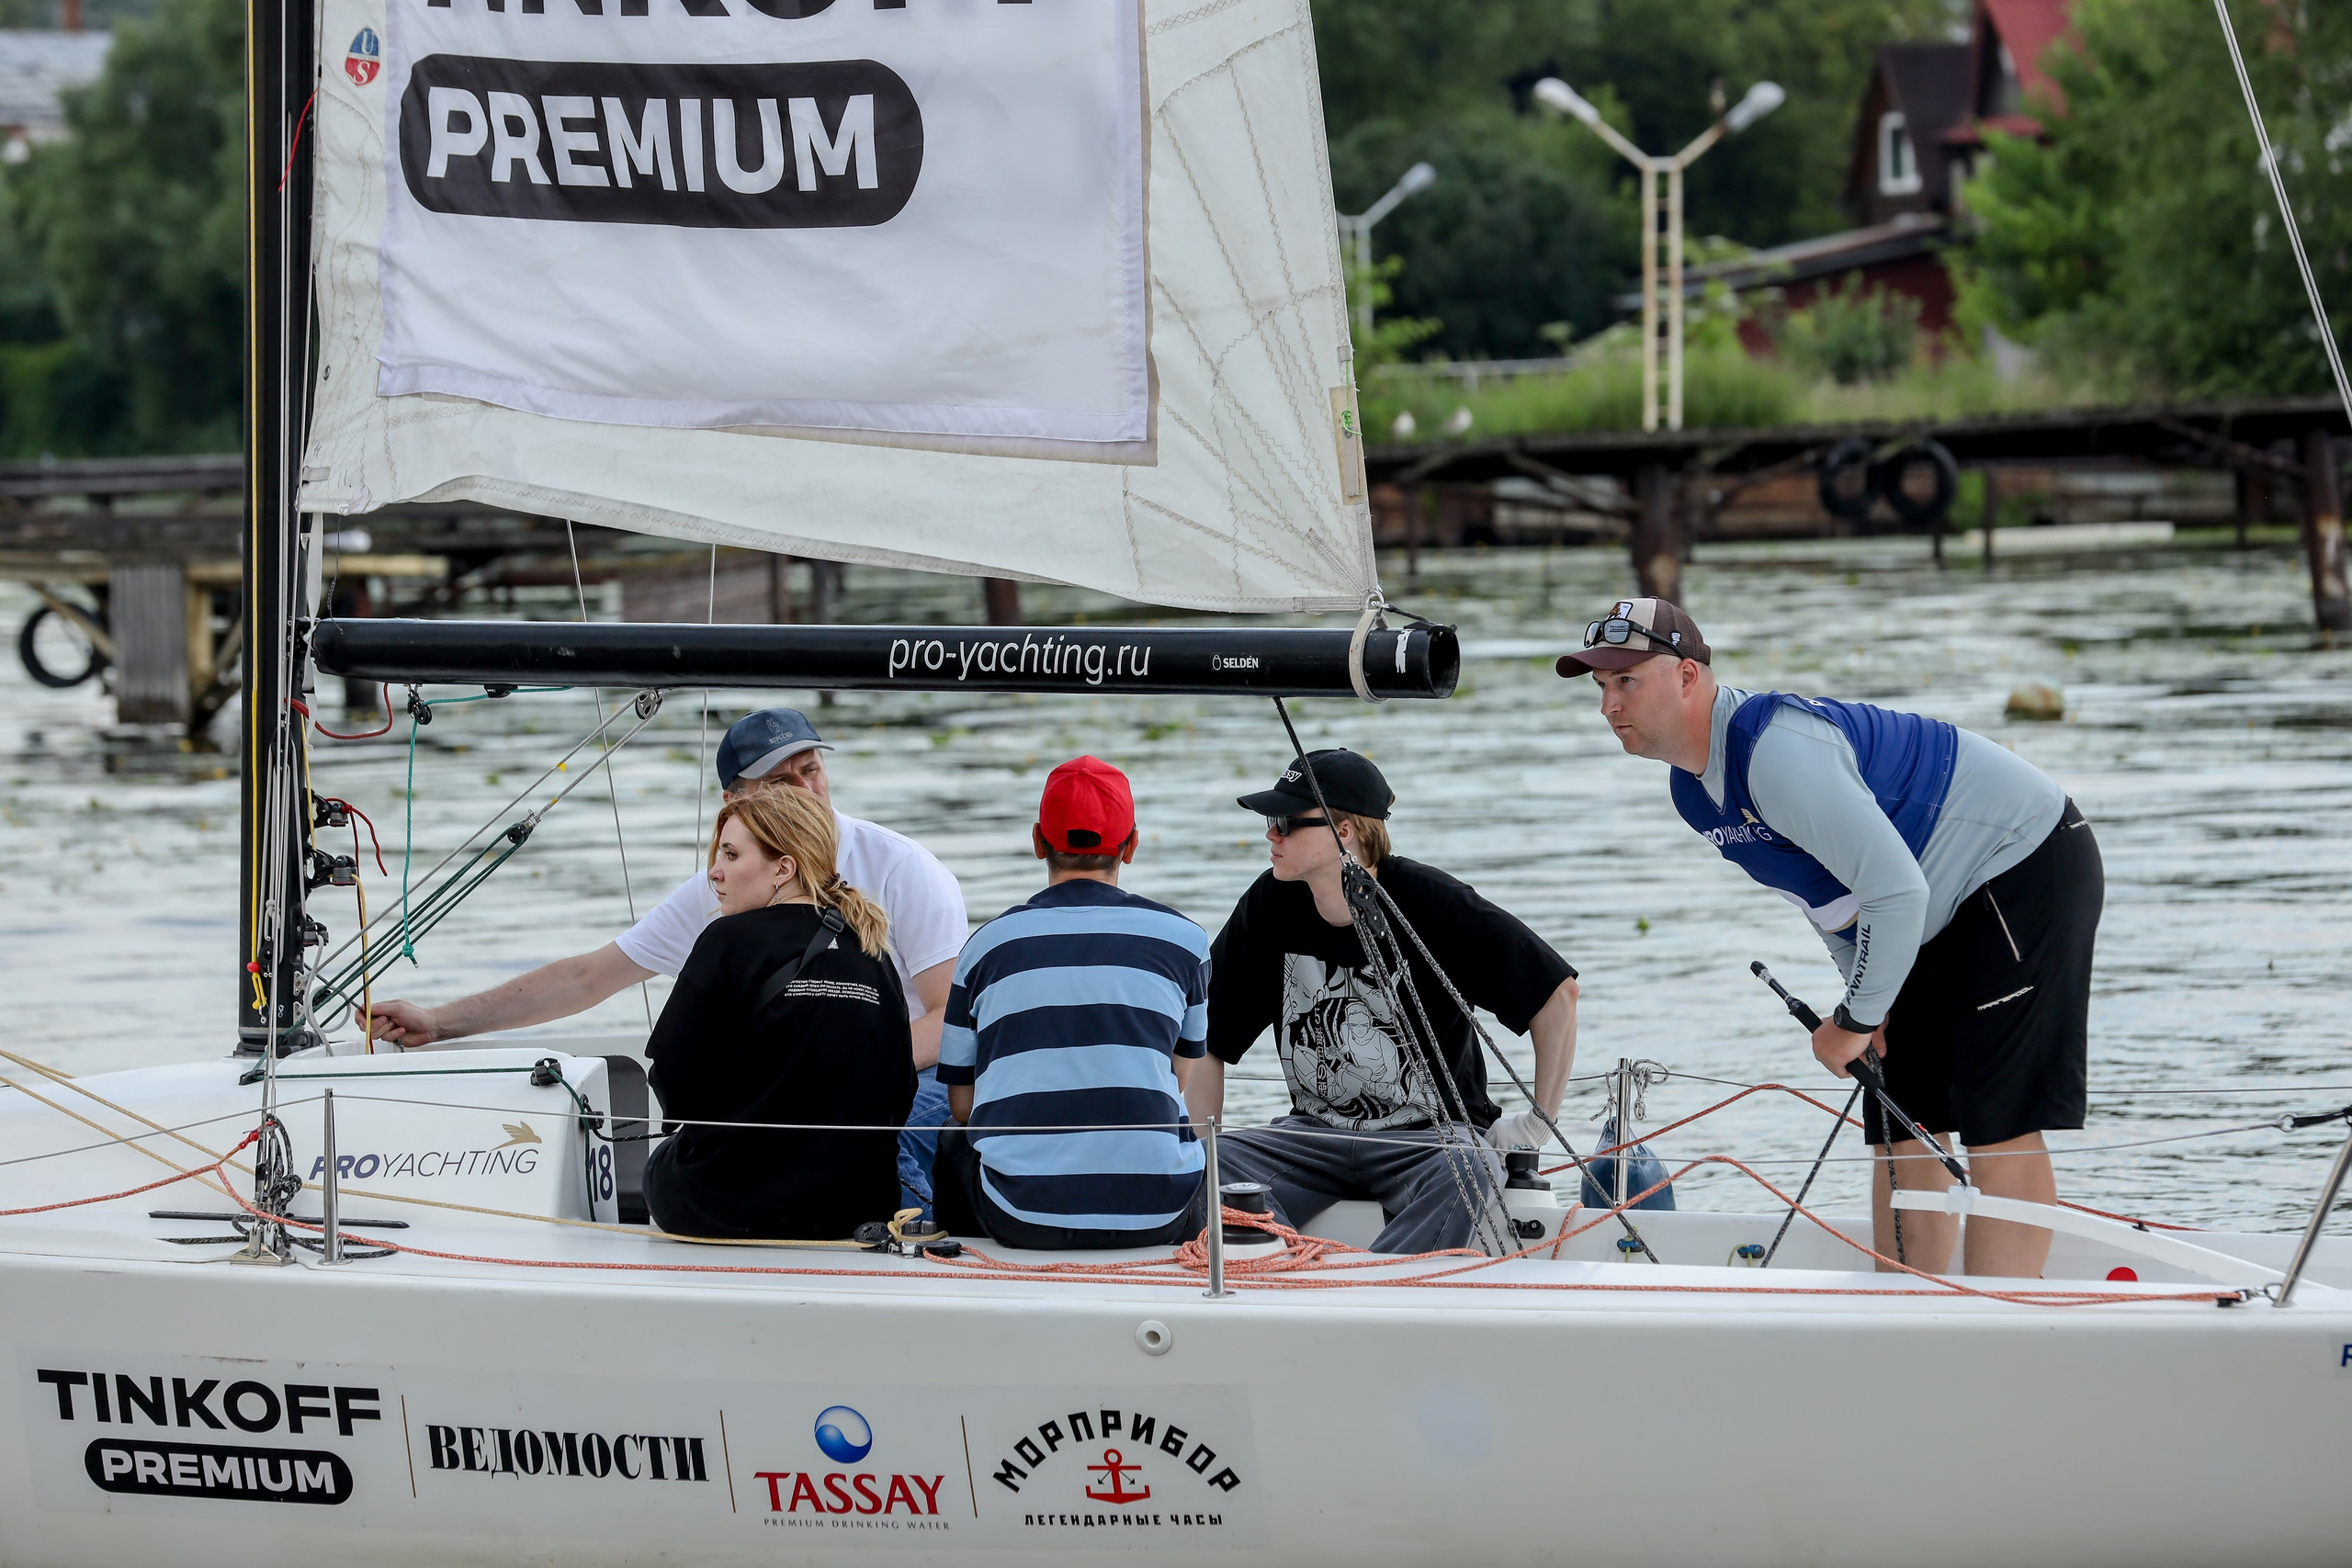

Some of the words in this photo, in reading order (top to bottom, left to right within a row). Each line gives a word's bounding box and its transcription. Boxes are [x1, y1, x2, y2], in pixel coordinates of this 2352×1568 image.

[425, 86, 879, 194] PREMIUM
[888, 633, 1150, 684] pro-yachting.ru
[1223, 655, 1259, 669] SELDÉN
[589, 1145, 613, 1202] 18
[37, 1369, 381, 1437] TINKOFF
[100, 1449, 335, 1495] PREMIUM
[425, 1424, 710, 1483] ВЕДОМОСТИ
[992, 1409, 1241, 1493] МОРПРИБОР
[753, 1472, 945, 1515] TASSAY
[763, 1518, 824, 1528] PREMIUM
[831, 1519, 899, 1529] DRINKING
[907, 1521, 950, 1530] WATER
[1024, 1514, 1161, 1528] ЛЕГЕНДАРНЫЕ
[1170, 1514, 1223, 1526] ЧАСЫ
